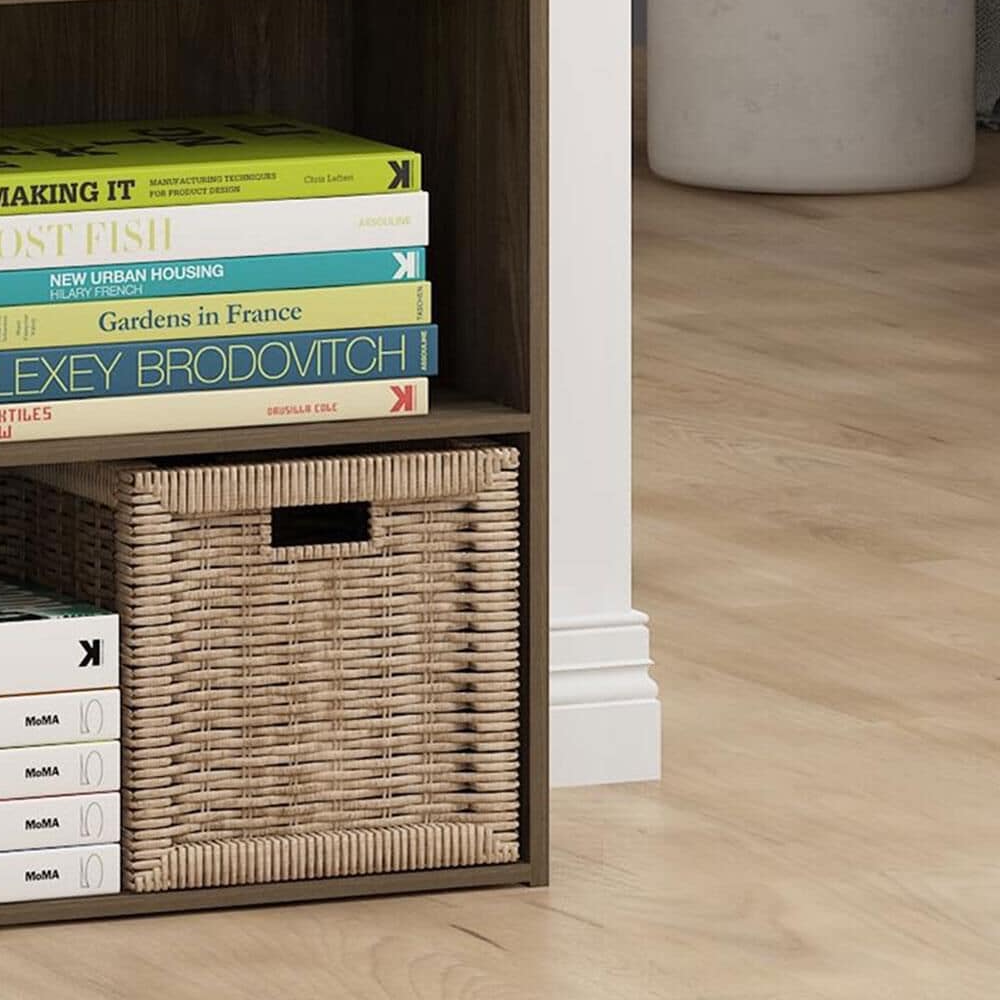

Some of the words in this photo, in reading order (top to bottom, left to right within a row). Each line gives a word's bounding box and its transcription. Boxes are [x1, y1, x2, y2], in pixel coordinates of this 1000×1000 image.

[149, 174, 224, 186] MANUFACTURING
[225, 171, 277, 183] TECHNIQUES
[107, 179, 135, 201] IT
[149, 189, 166, 198] FOR
[168, 187, 208, 197] PRODUCT
[209, 185, 241, 195] DESIGN
[358, 215, 412, 228] ASSOULINE
[86, 216, 172, 256] FISH
[50, 272, 87, 288] NEW
[91, 268, 147, 285] URBAN
[151, 264, 224, 281] HOUSING
[50, 287, 92, 299] HILARY
[94, 284, 143, 297] FRENCH
[98, 309, 191, 333] Gardens
[198, 306, 219, 326] in
[226, 304, 303, 325] France
[137, 333, 406, 388] BRODOVITCH
[25, 714, 60, 727] MoMA
[25, 766, 60, 779] MoMA
[25, 817, 60, 830] MoMA
[25, 869, 60, 882] MoMA
